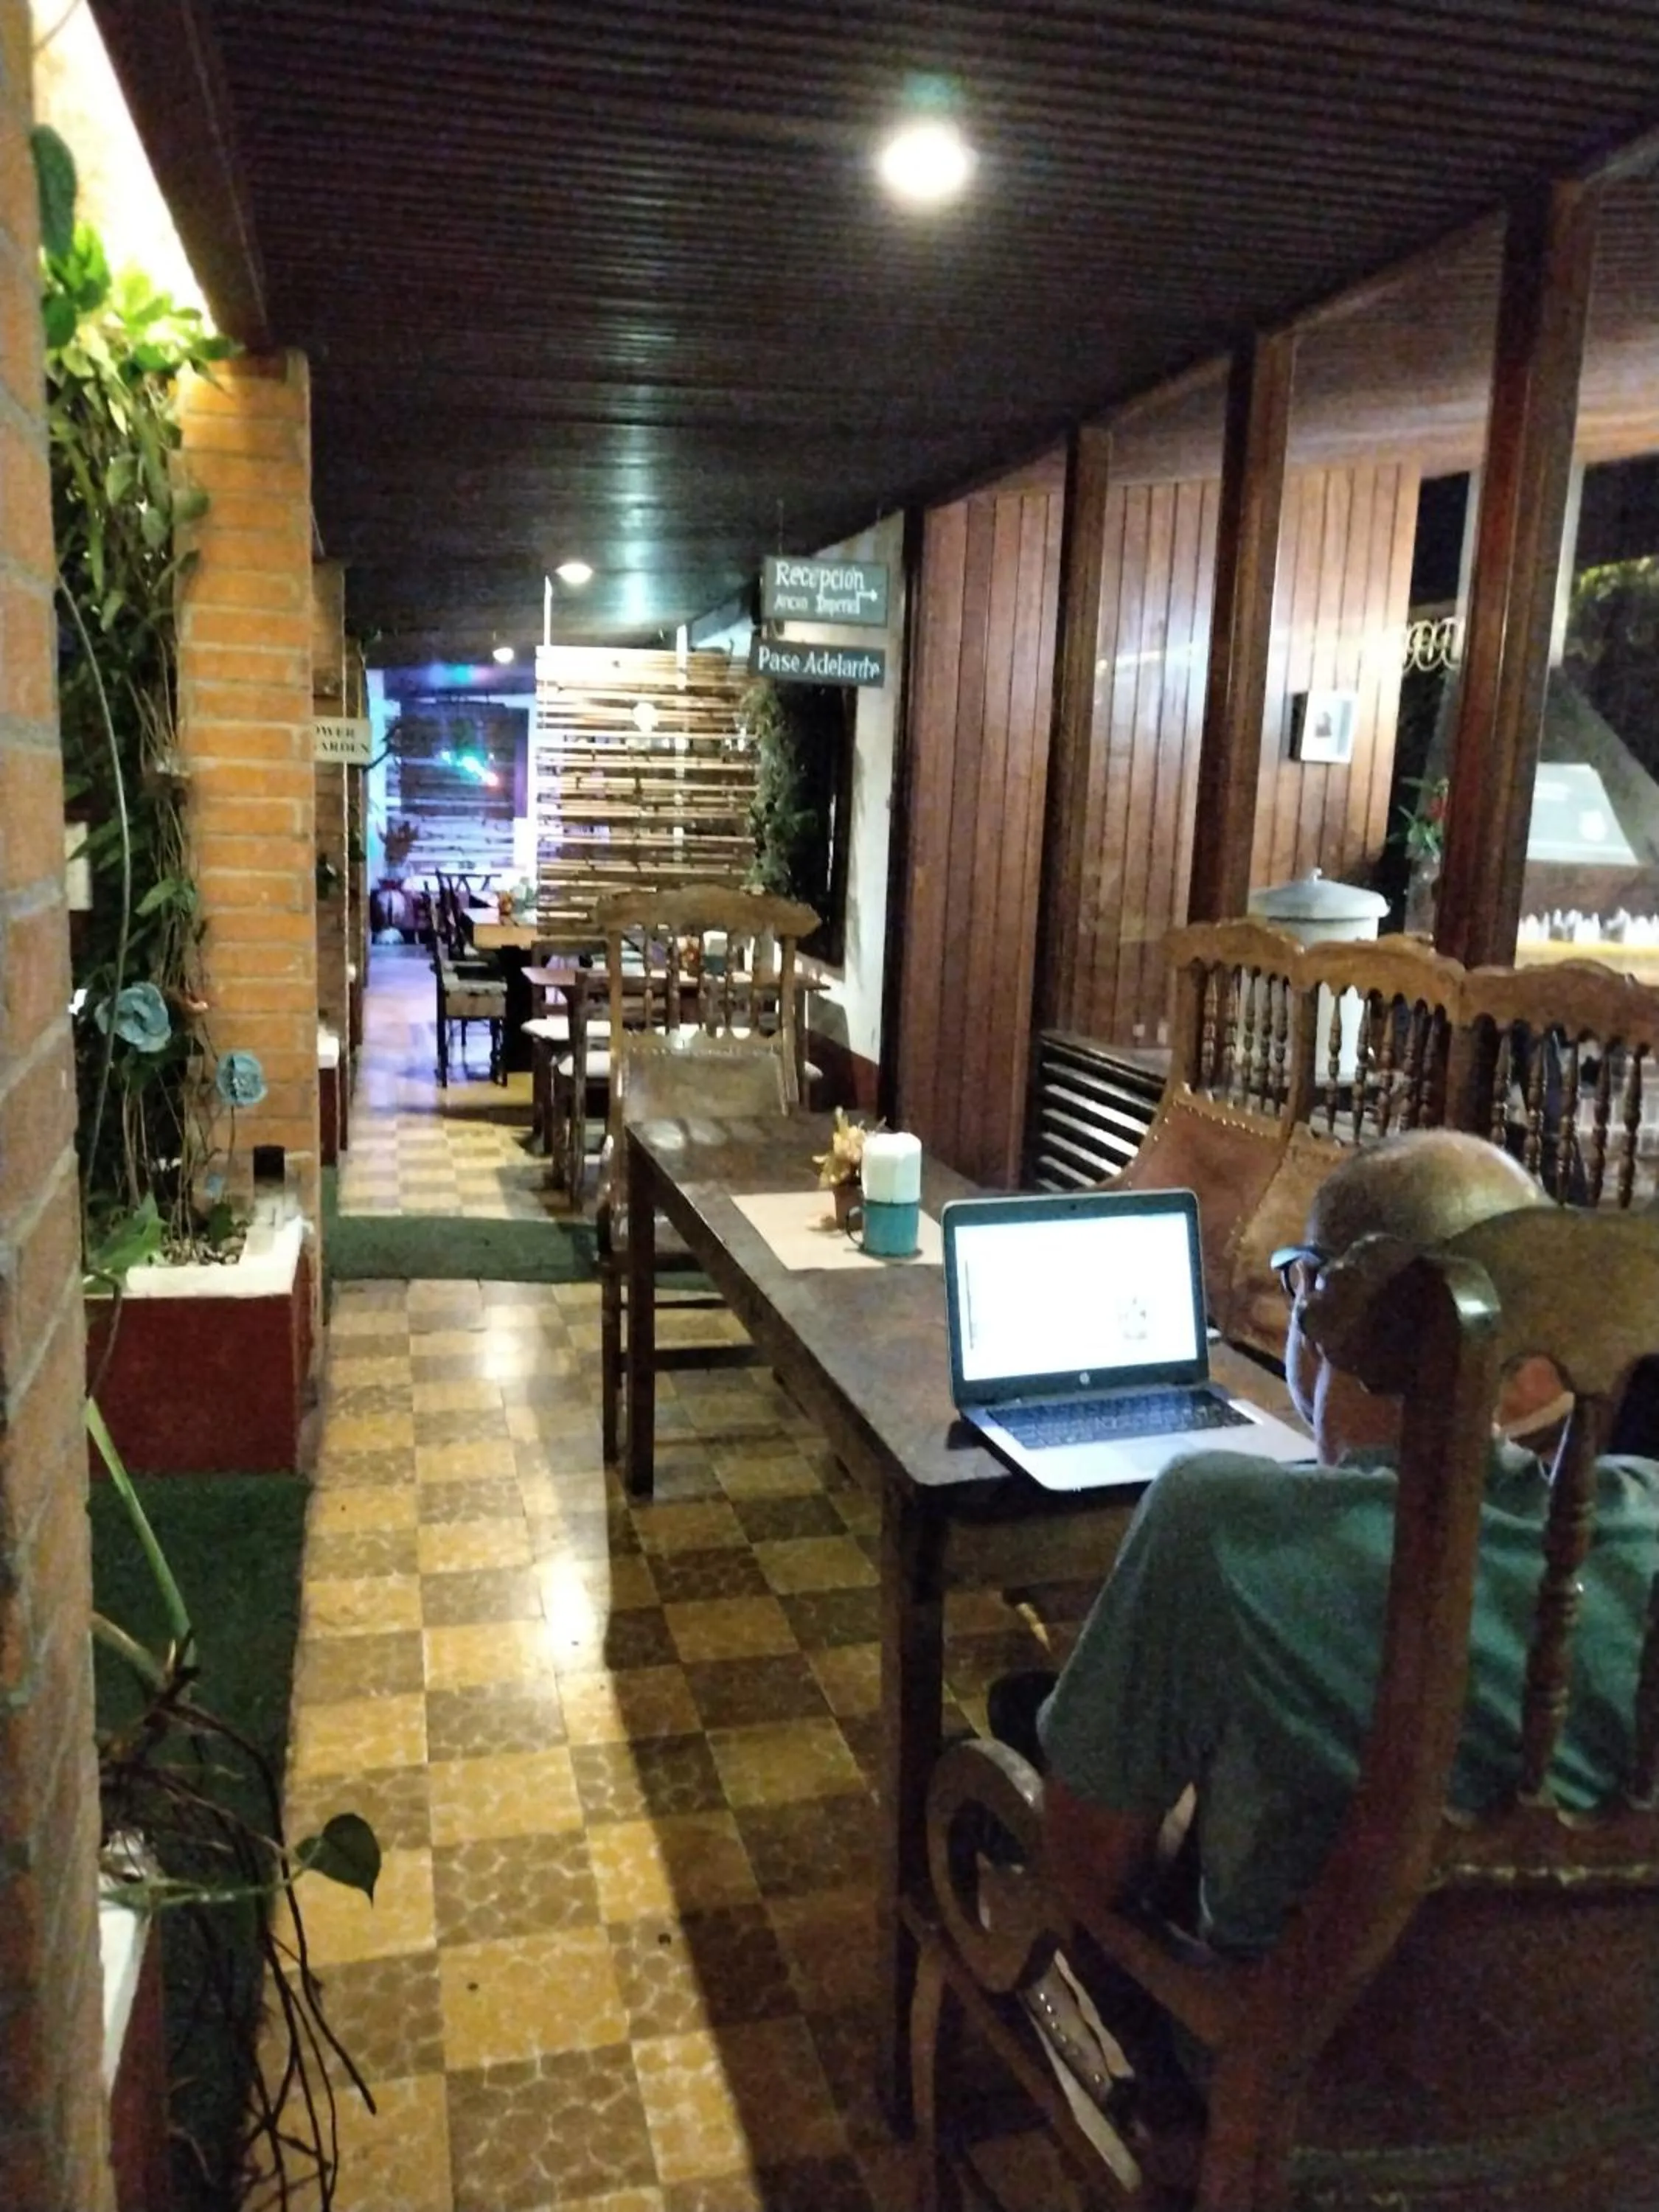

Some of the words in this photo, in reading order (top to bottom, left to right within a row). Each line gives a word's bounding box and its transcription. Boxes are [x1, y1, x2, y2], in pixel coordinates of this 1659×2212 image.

[758, 644, 800, 672] Pase
[802, 650, 880, 680] Adelante
[314, 741, 370, 753] ARDEN
